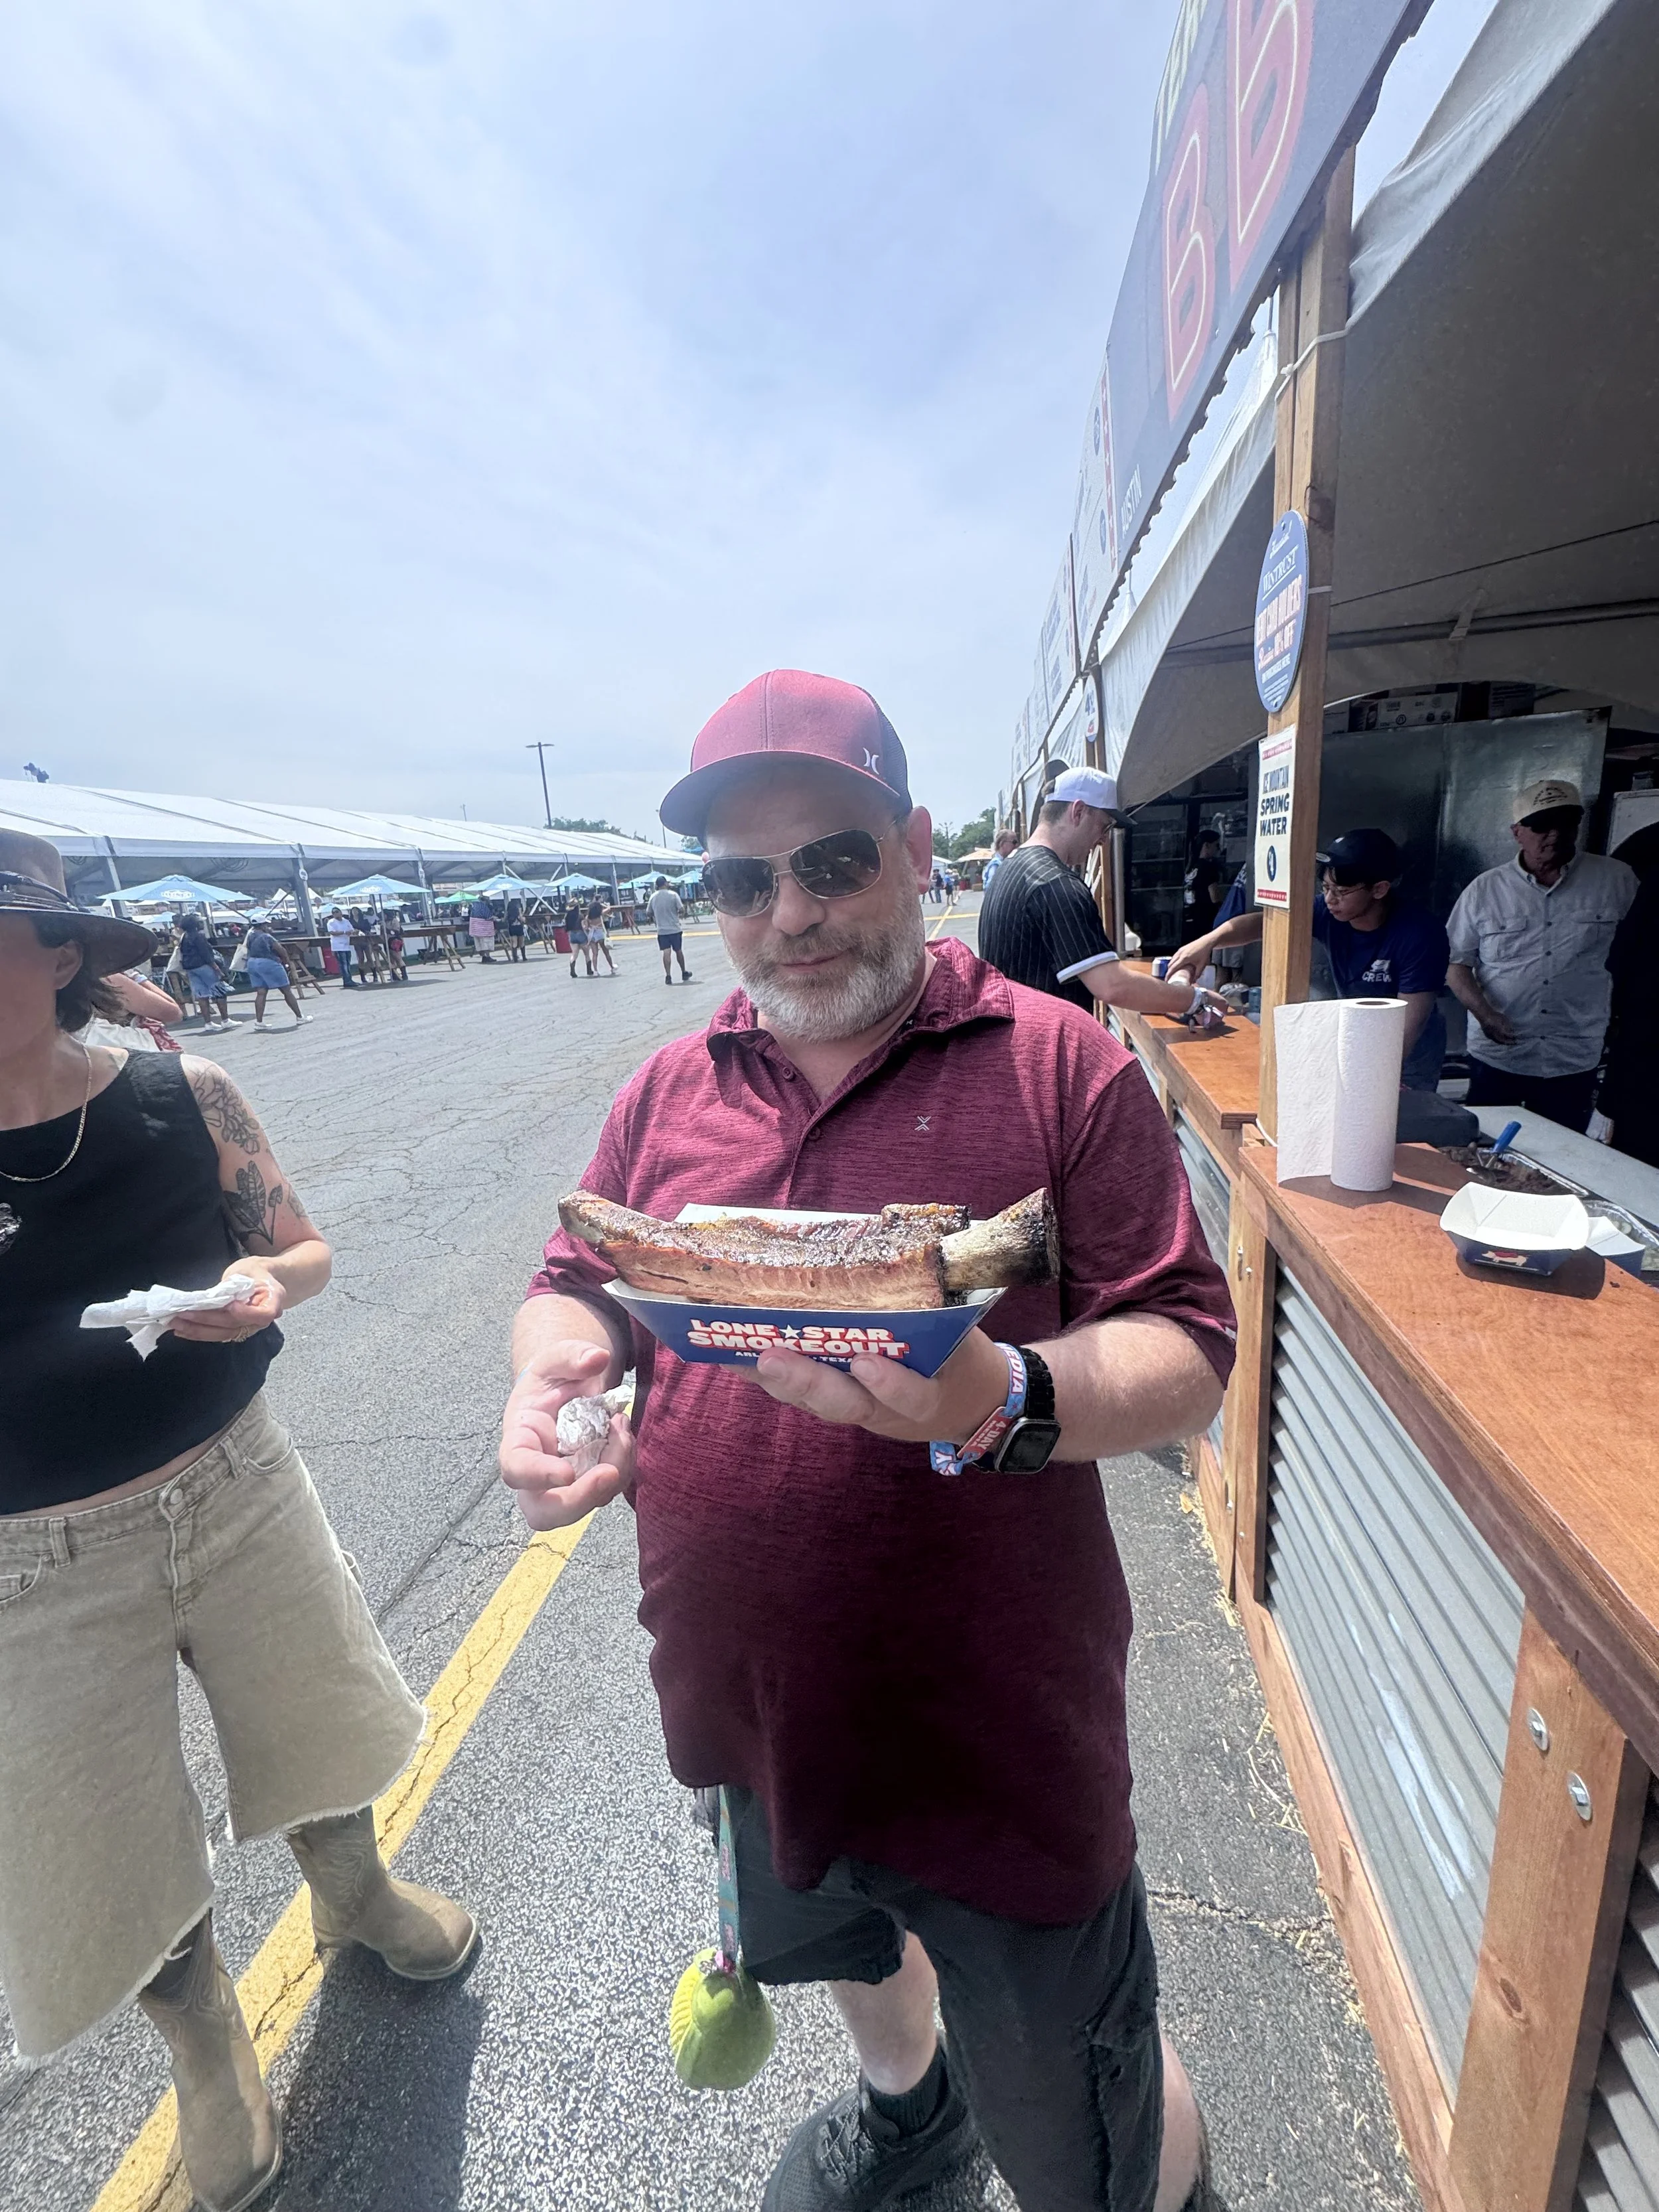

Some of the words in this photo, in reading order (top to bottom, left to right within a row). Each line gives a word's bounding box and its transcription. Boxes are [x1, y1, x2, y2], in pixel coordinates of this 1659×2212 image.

[1121, 463, 1142, 539] AUSTIN
[1263, 546, 1299, 594] WINTRUST
[1260, 792, 1290, 816] SPRING
[1260, 816, 1287, 837] WATER
[1361, 971, 1392, 983] CREW
[690, 1318, 781, 1336] LONE
[802, 1325, 893, 1341] STAR
[687, 1331, 908, 1358] SMOKEOUT
[970, 1420, 997, 1447] MEDIA
[977, 1420, 1007, 1450] 4-DAY
